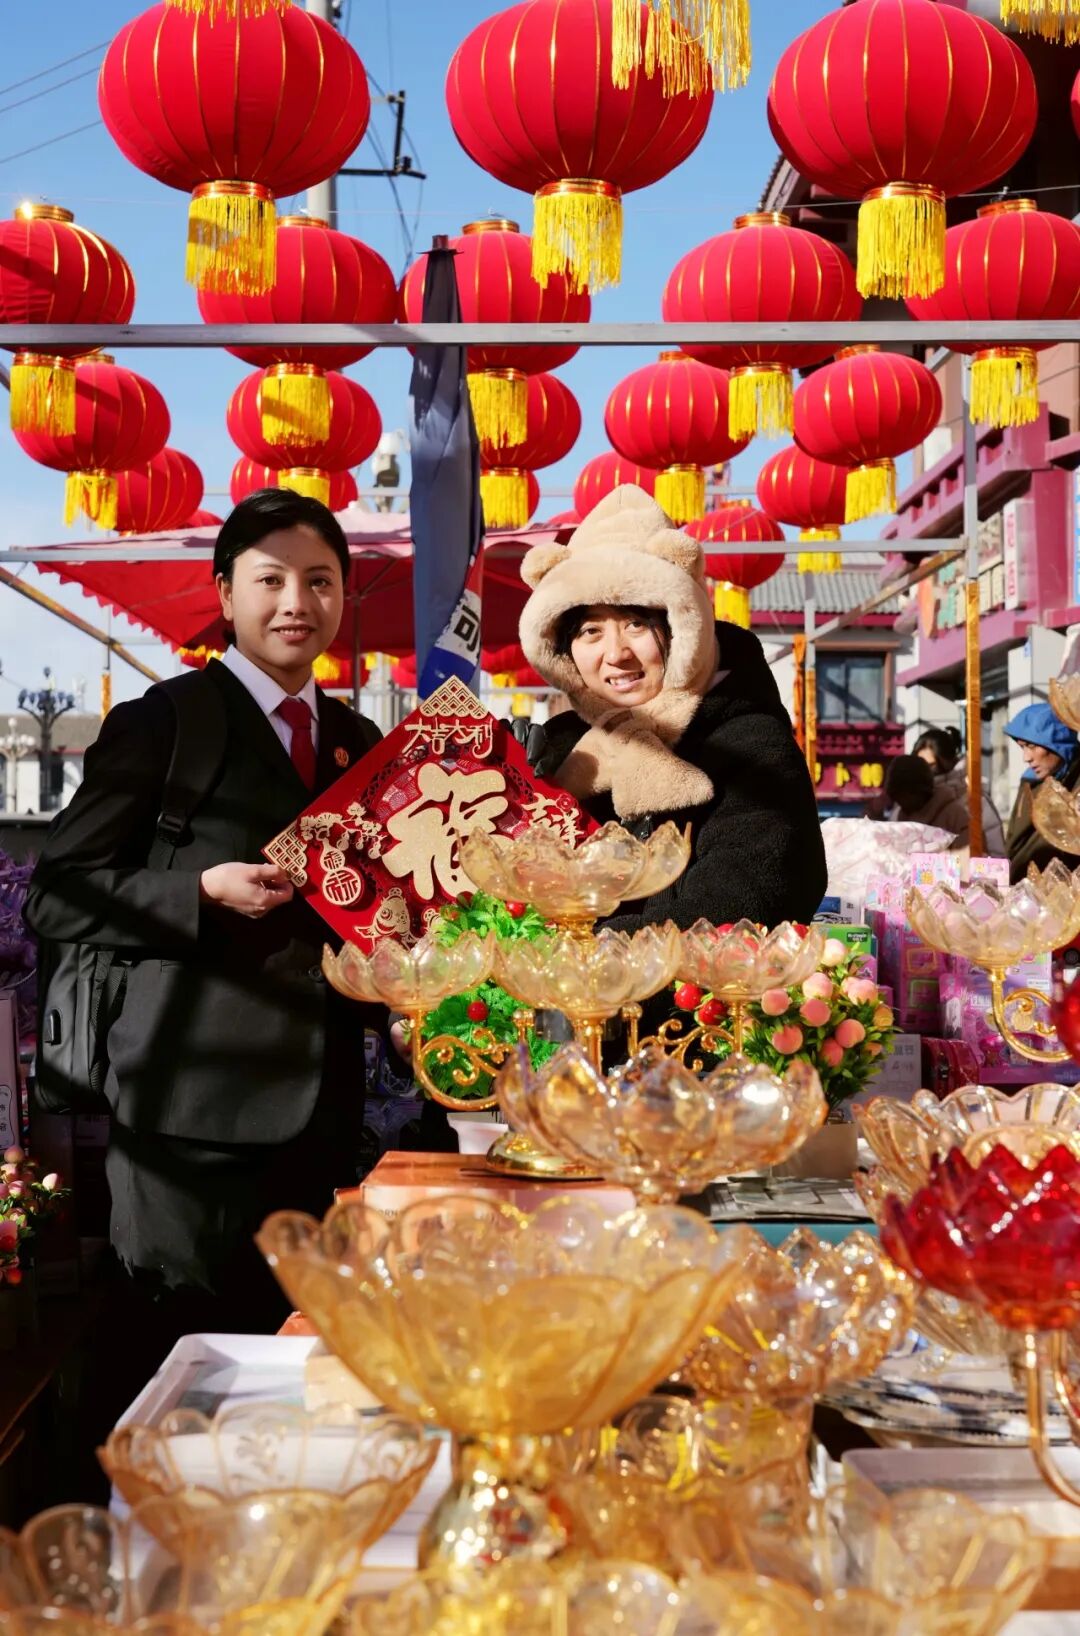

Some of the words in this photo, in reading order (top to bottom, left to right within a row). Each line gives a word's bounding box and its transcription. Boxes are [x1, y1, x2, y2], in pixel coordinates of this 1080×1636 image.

[401, 717, 494, 760] 大吉大利
[382, 762, 512, 900] 福
